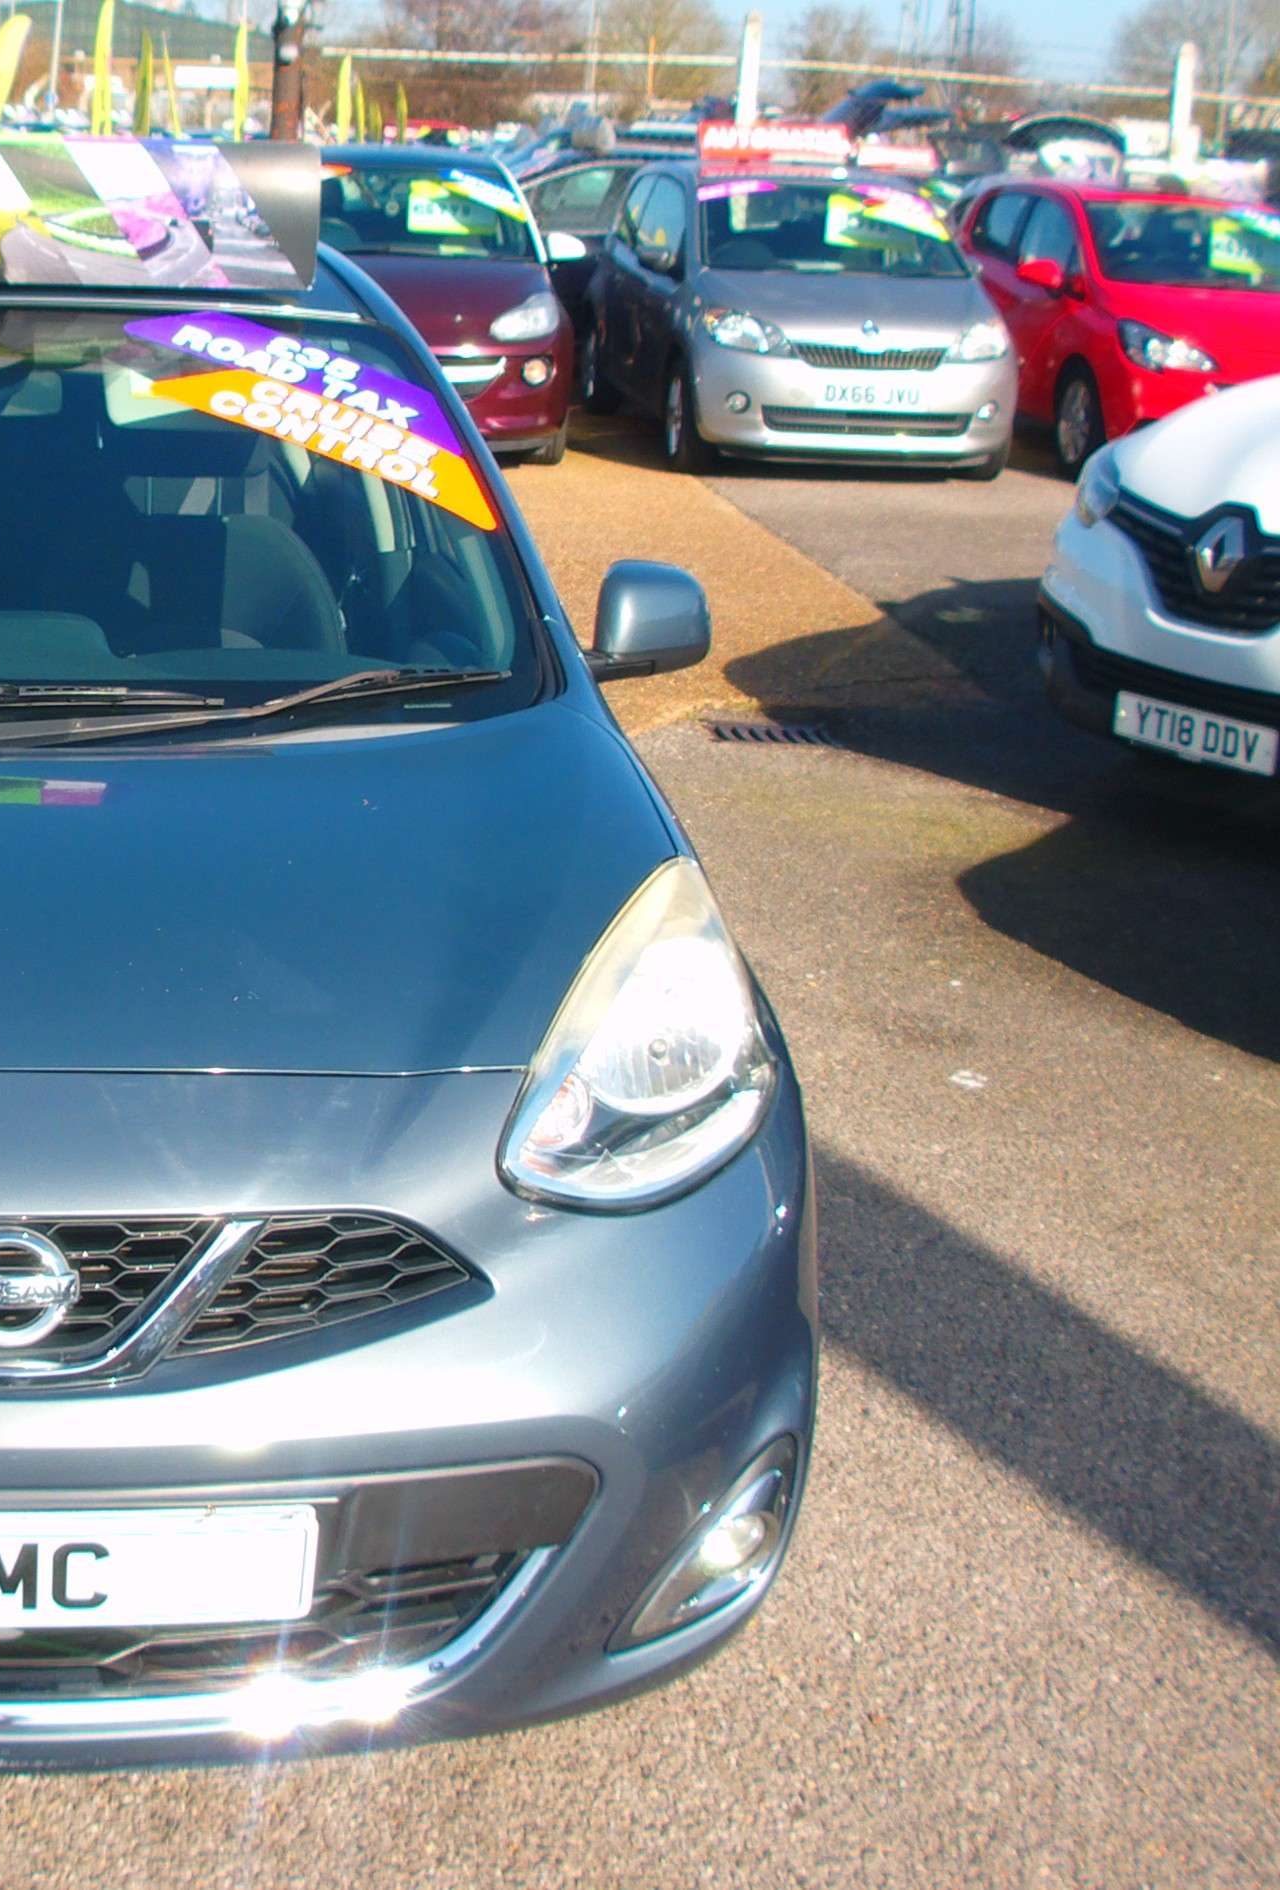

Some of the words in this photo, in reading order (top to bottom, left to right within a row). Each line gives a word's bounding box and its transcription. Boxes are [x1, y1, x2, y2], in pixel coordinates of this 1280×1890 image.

[171, 324, 308, 384] ROAD
[322, 375, 419, 429] TAX
[251, 380, 439, 467] CRUISE
[824, 384, 876, 403] DX66
[884, 387, 920, 405] JVU
[209, 390, 441, 498] CONTROL
